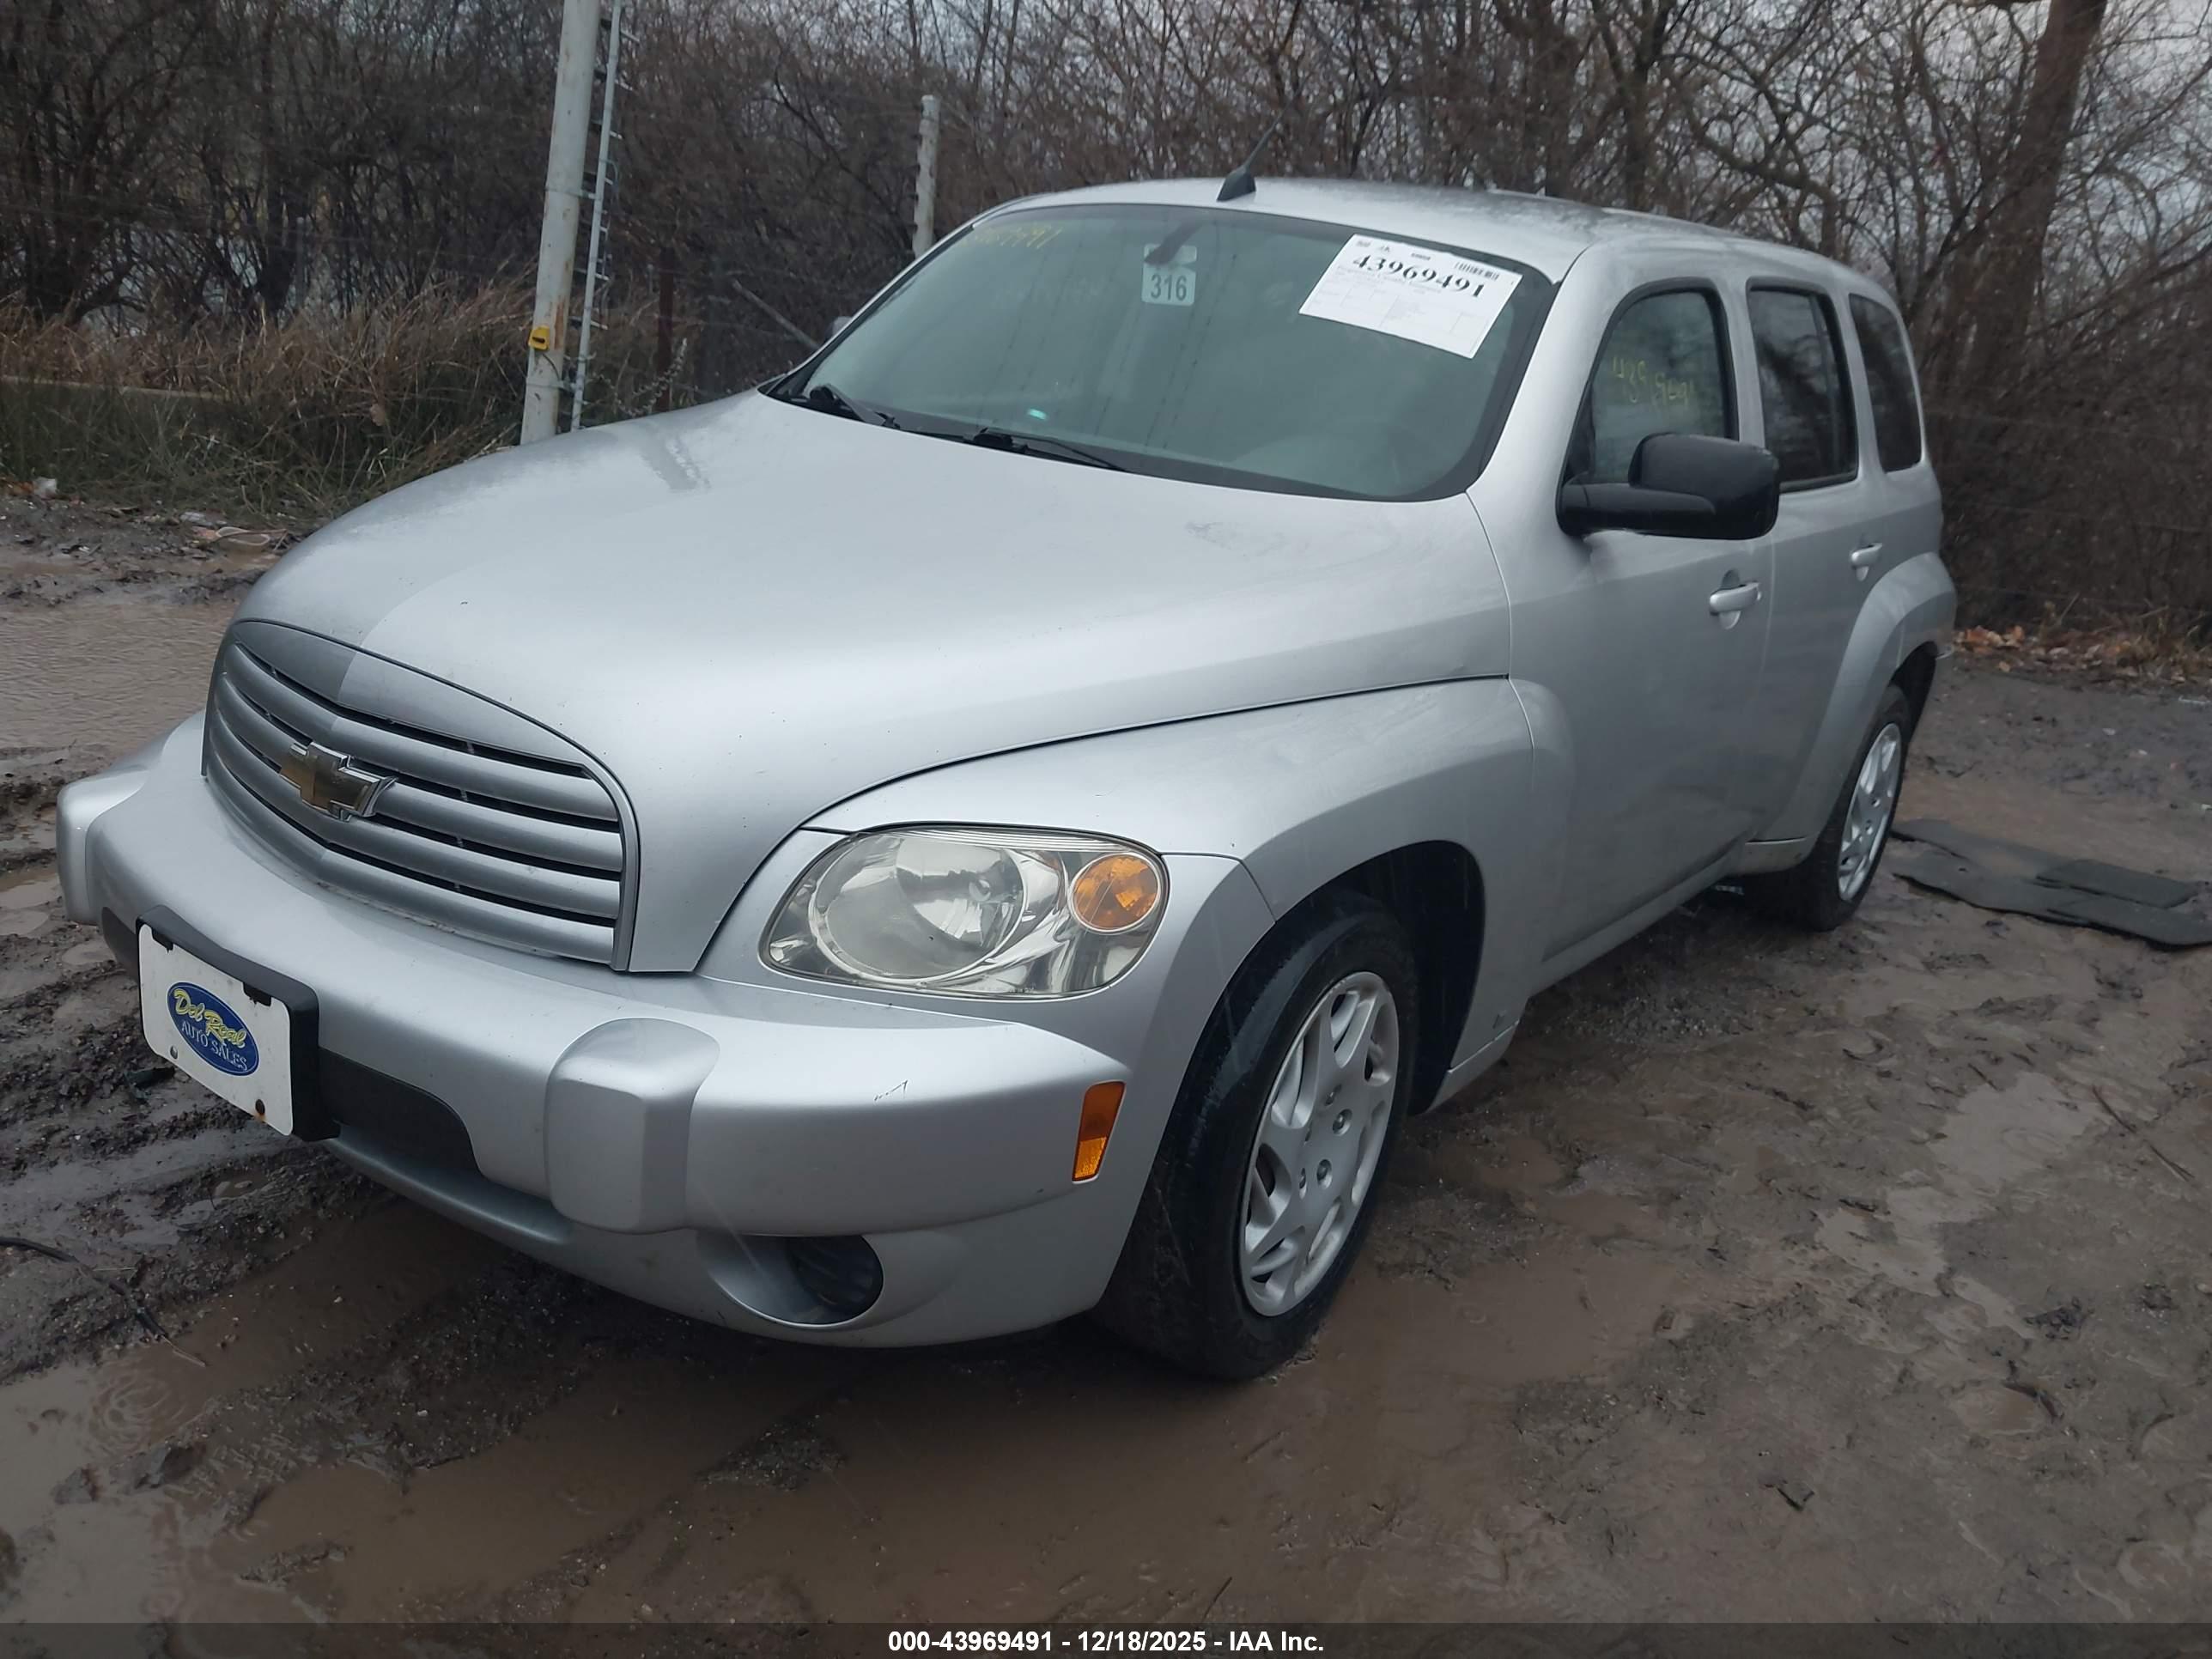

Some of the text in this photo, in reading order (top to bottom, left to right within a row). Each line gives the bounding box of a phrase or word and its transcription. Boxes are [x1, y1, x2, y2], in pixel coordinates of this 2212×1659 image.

[1151, 273, 1187, 301] 316
[1353, 254, 1486, 298] 43969491
[173, 988, 247, 1048] Del Real
[181, 1020, 247, 1072] AUTO SALES
